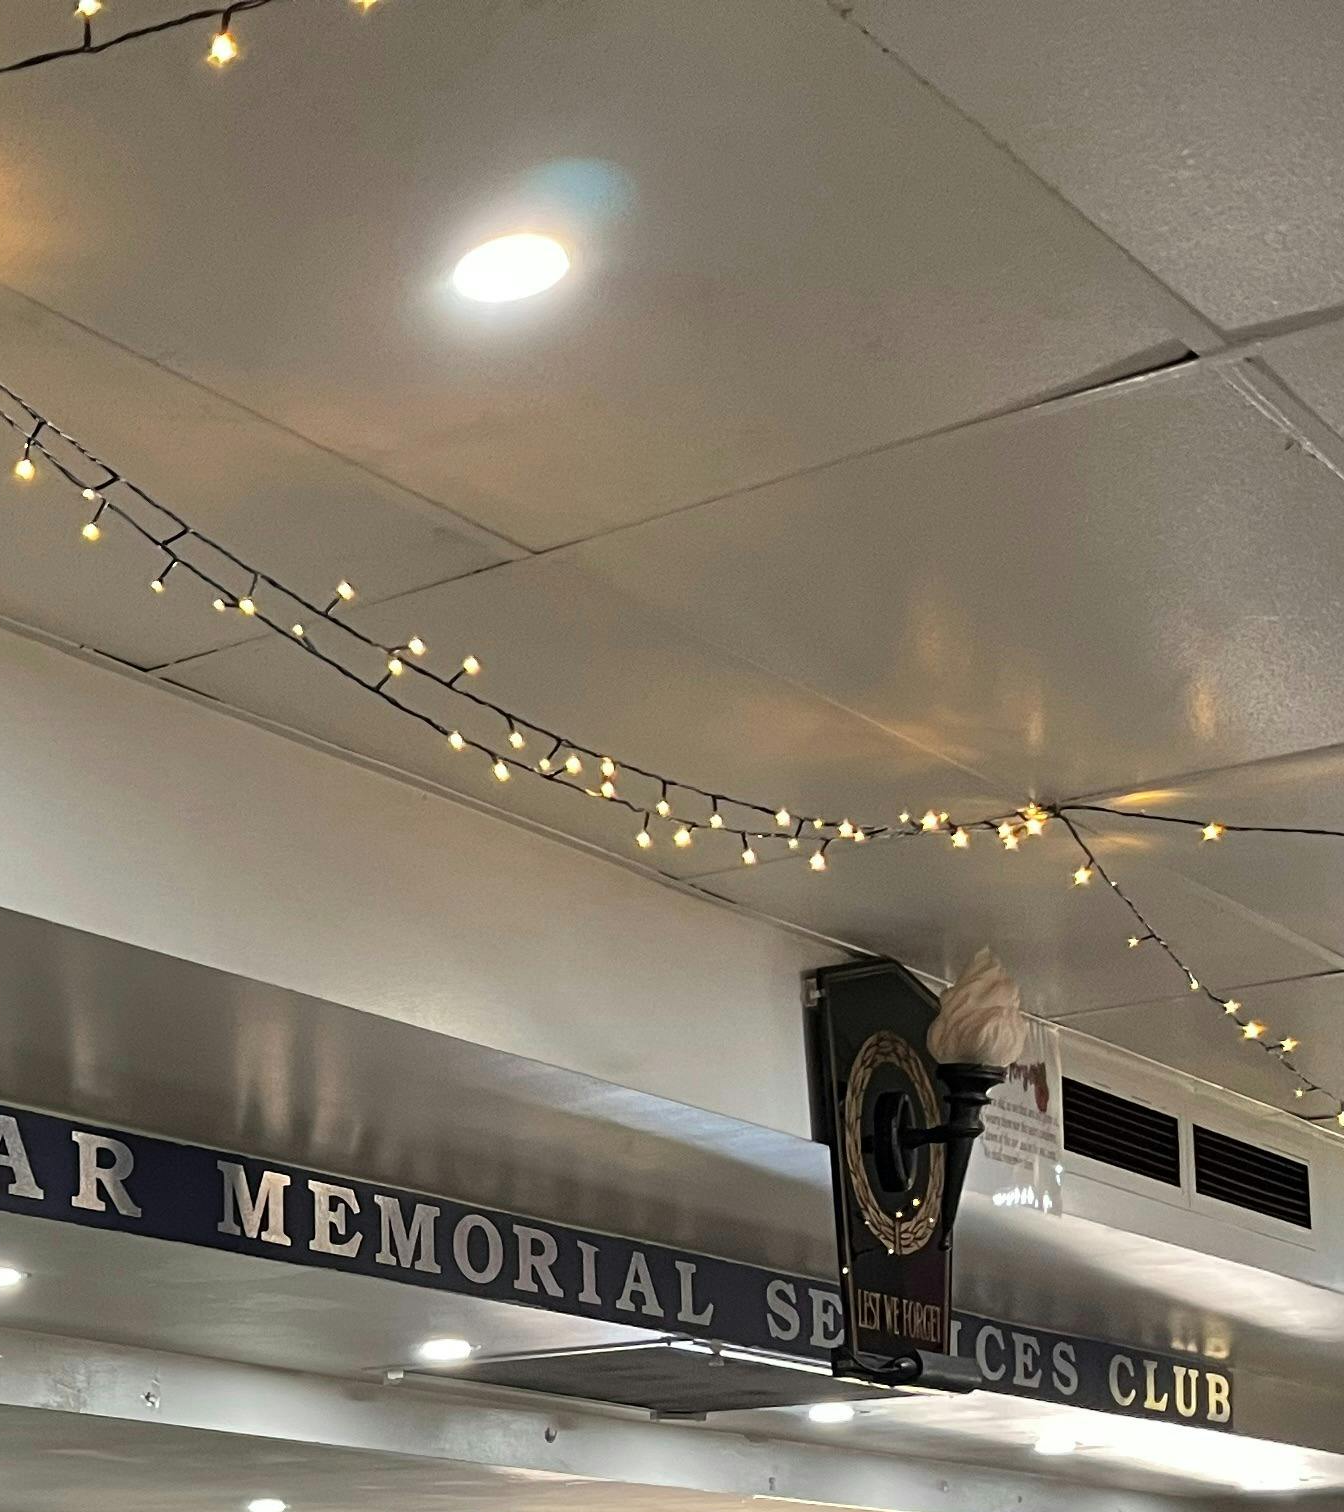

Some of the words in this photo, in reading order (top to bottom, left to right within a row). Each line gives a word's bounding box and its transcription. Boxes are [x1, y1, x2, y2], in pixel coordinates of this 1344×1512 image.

[216, 1159, 714, 1327] MEMORIAL
[765, 1279, 1080, 1396] SEICES
[1109, 1354, 1232, 1424] CLUB
[857, 1288, 880, 1331] LEST
[883, 1294, 900, 1336] WE
[902, 1298, 941, 1343] FORGET
